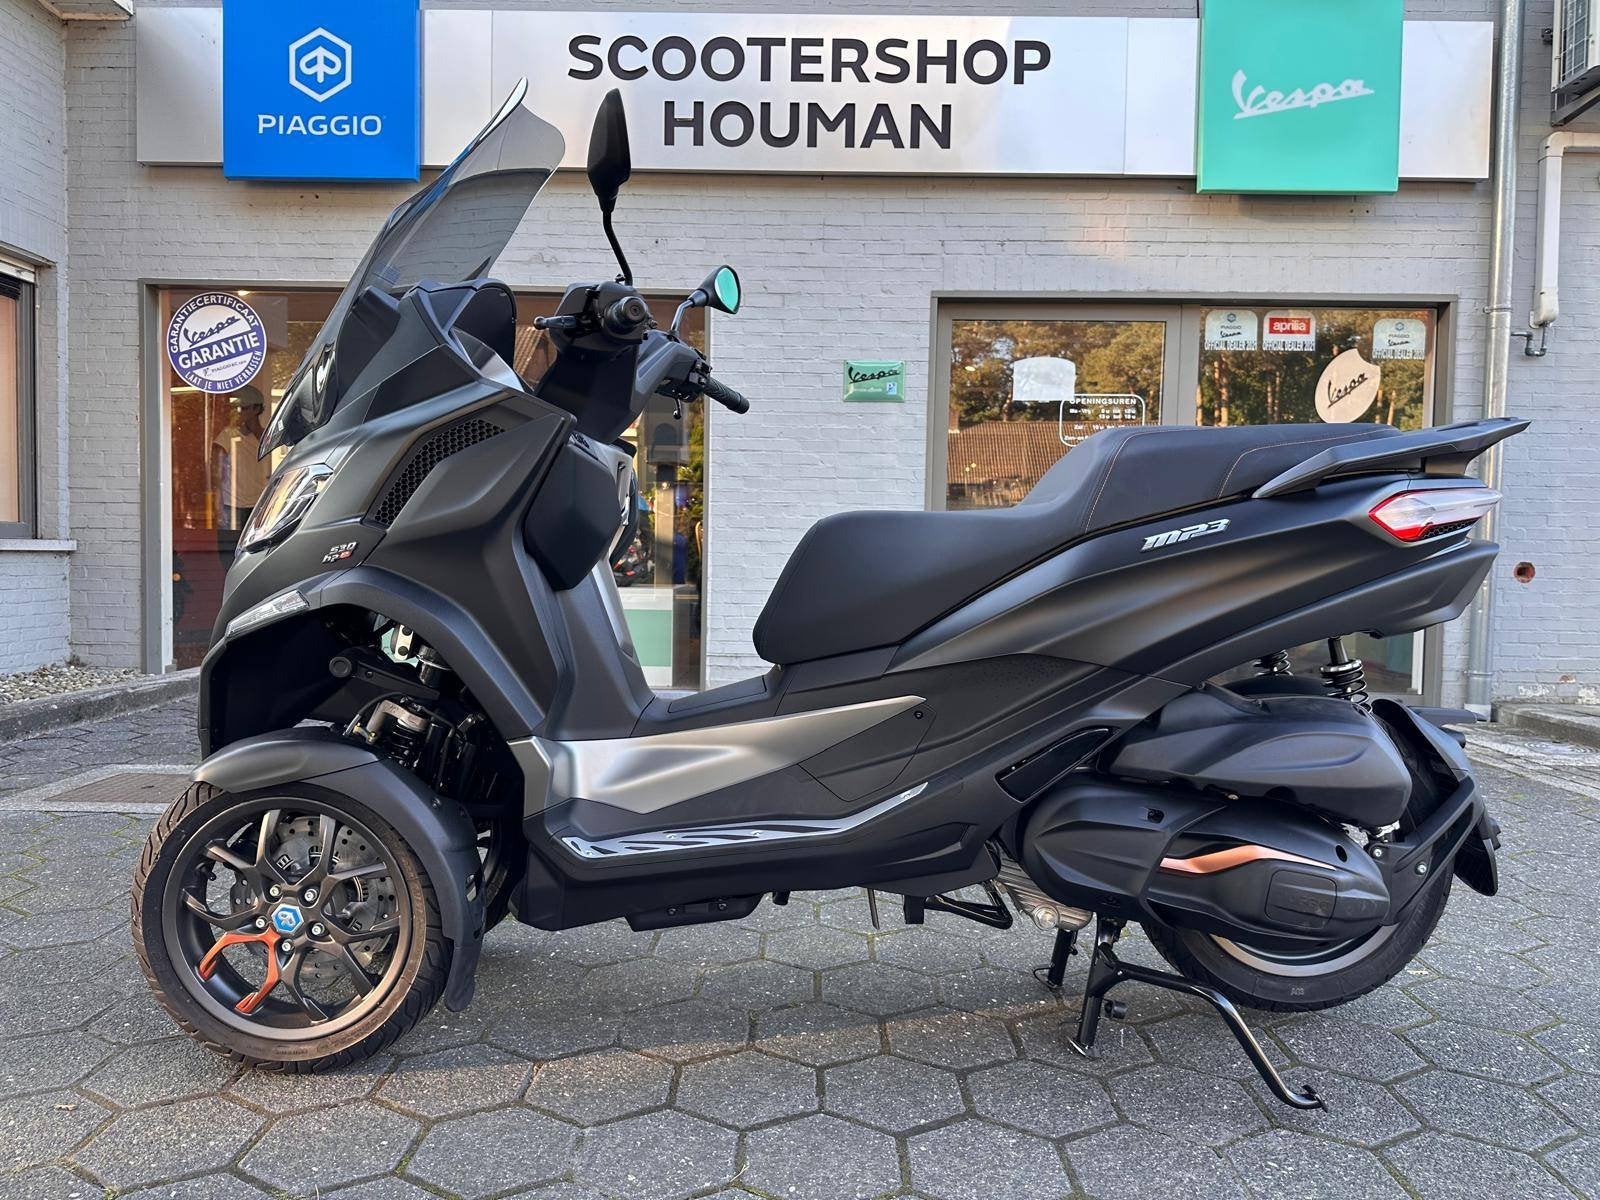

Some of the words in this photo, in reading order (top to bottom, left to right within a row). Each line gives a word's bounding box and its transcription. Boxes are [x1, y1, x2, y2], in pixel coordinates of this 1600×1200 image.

[567, 34, 1052, 85] SCOOTERSHOP
[1231, 69, 1375, 120] Vespa
[257, 114, 382, 136] PIAGGIO
[663, 100, 952, 150] HOUMAN
[183, 315, 241, 348] Vespa
[1273, 319, 1306, 332] aprilia
[178, 332, 260, 369] GARANTIE
[185, 371, 200, 386] LAAT
[204, 380, 212, 390] JE
[217, 380, 234, 390] NIET
[235, 351, 263, 385] VERRASSEN
[848, 366, 901, 384] Vespa
[1327, 372, 1368, 409] Vespa
[1140, 518, 1231, 551] MP3
